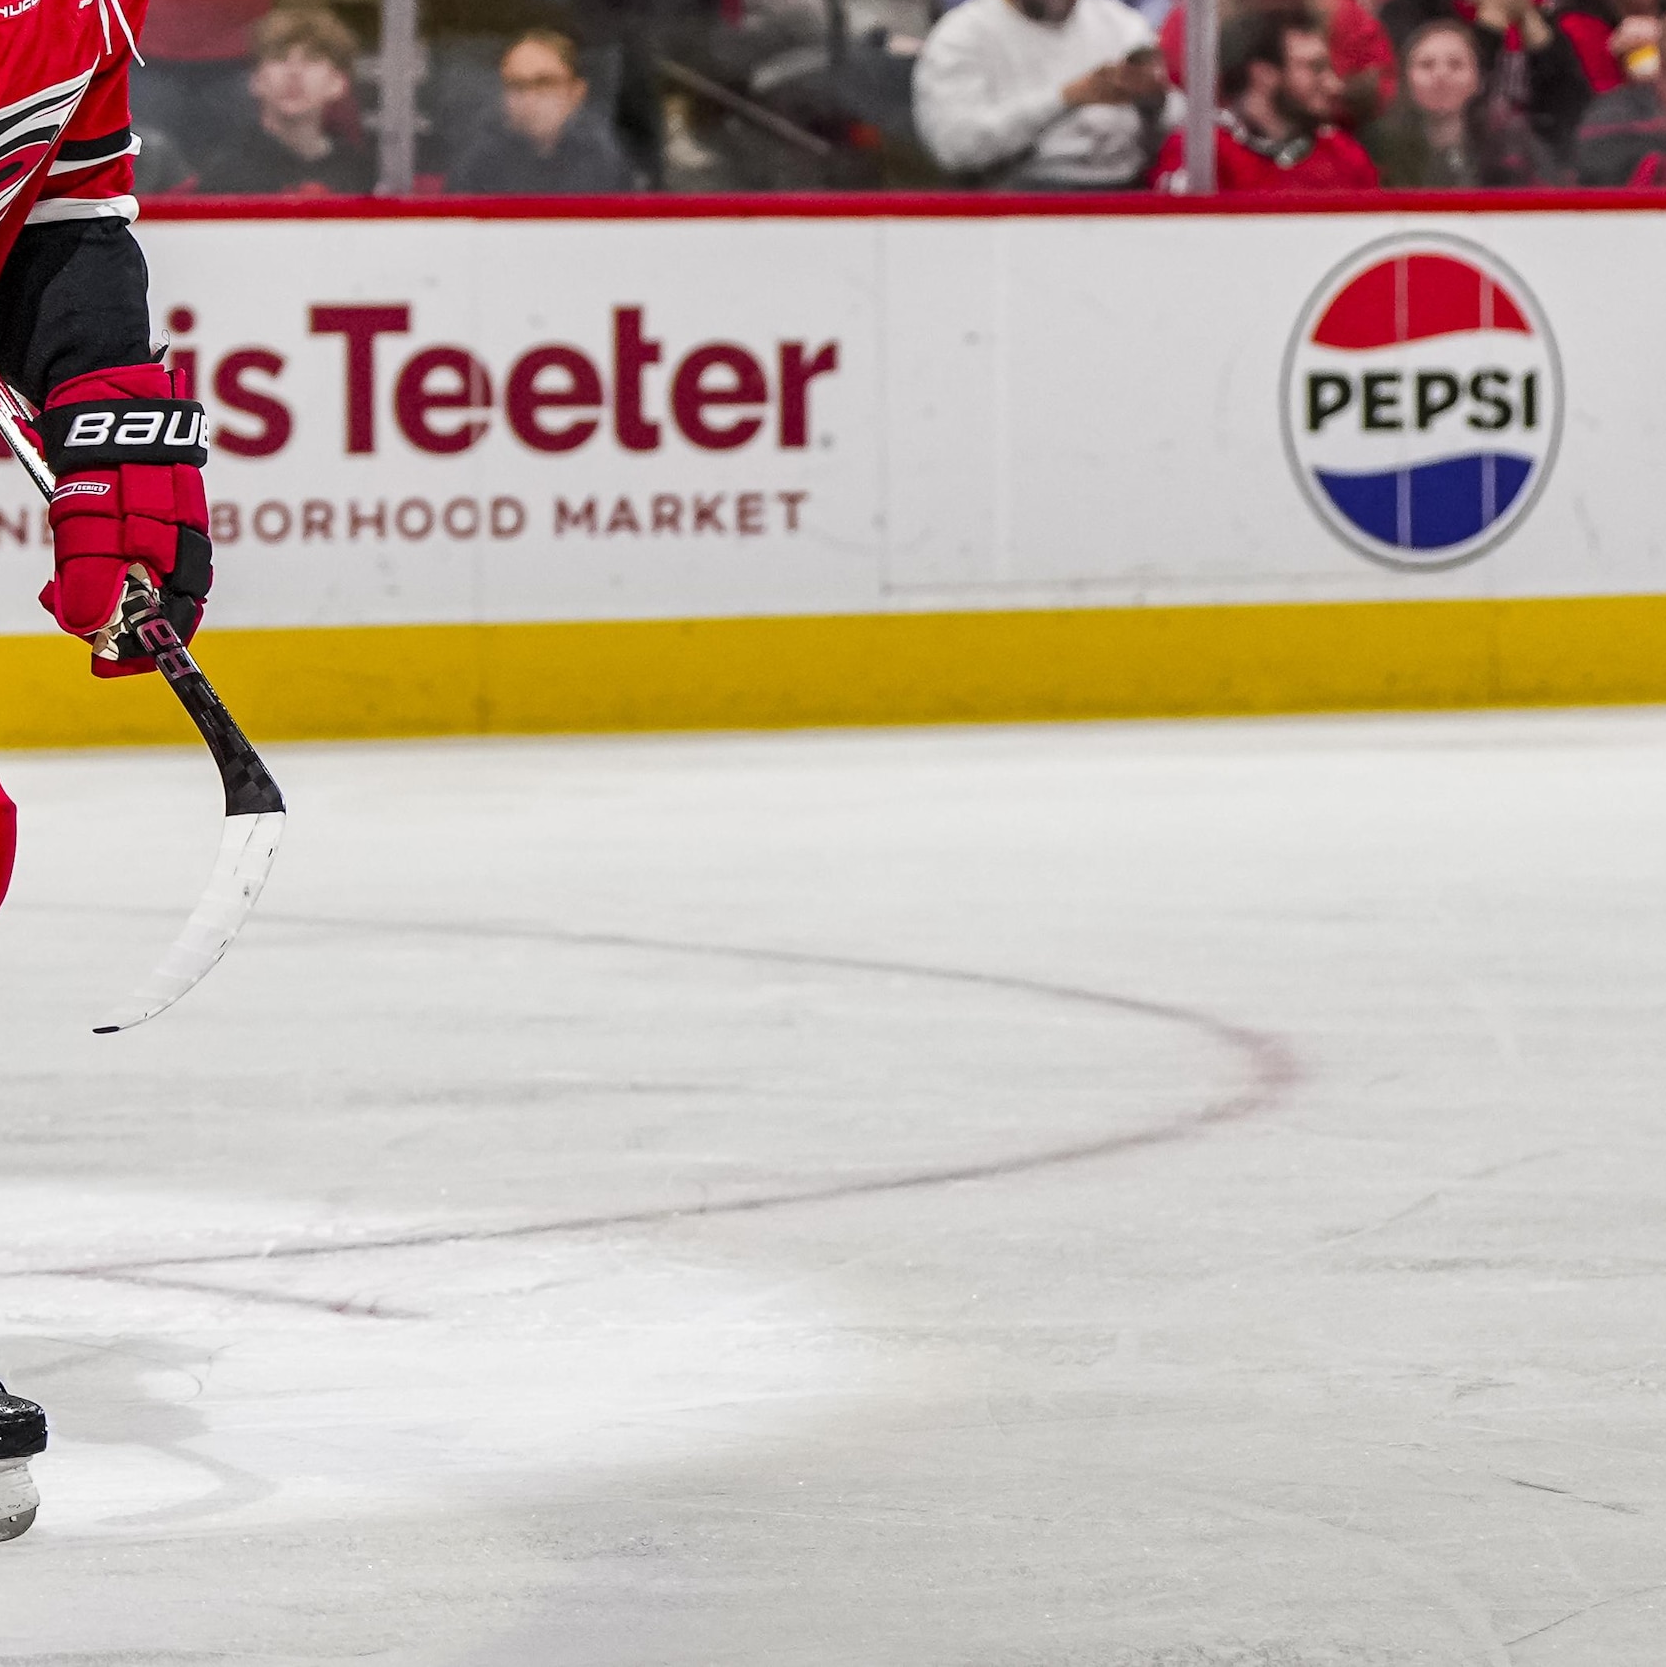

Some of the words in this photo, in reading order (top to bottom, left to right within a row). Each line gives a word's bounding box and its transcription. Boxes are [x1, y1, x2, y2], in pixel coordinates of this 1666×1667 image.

[307, 300, 840, 457] Teeter
[1303, 366, 1541, 435] PEPSI
[64, 411, 211, 448] BAU
[553, 490, 810, 538] MARKET
